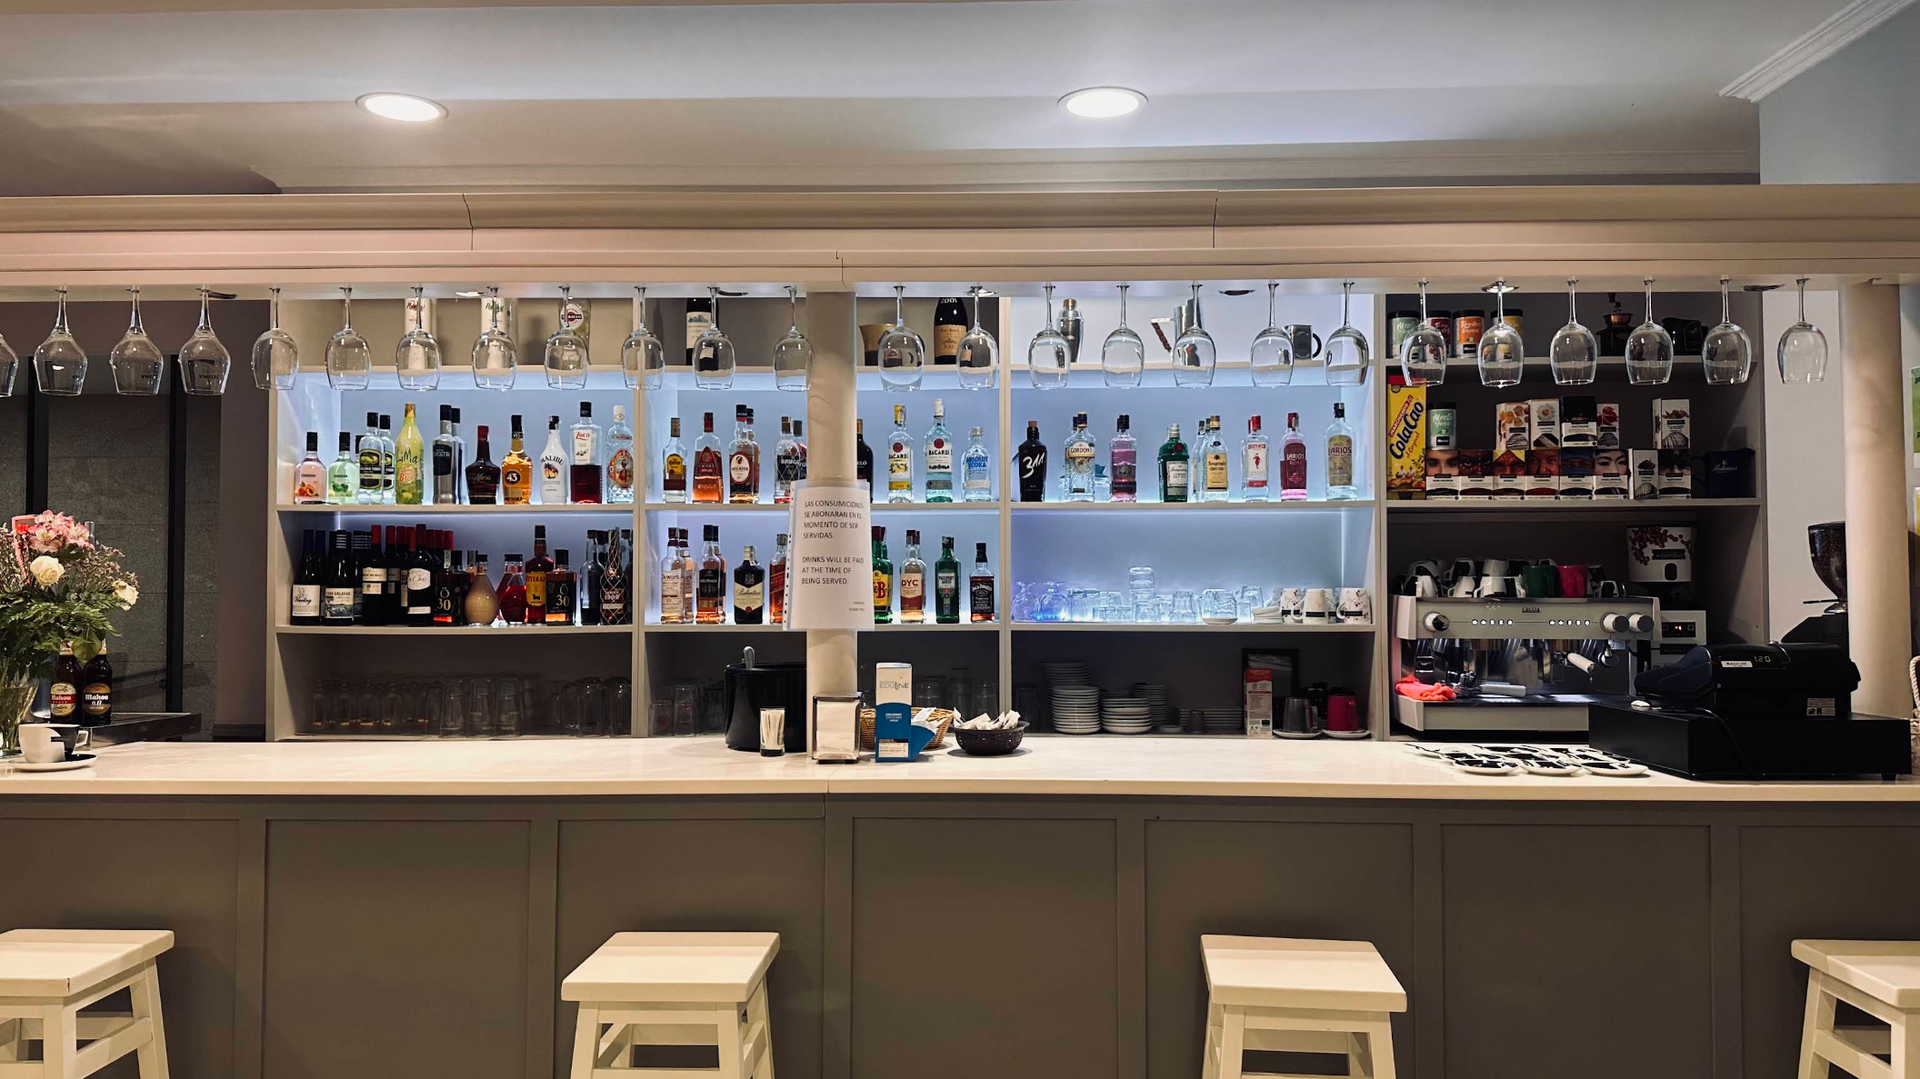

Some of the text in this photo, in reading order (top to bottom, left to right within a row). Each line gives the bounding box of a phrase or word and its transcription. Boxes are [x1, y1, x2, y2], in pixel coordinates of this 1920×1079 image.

[1389, 401, 1424, 460] ColaCao
[1328, 446, 1352, 456] LARIOS
[540, 455, 564, 466] MALIBU
[506, 473, 518, 482] 43
[815, 500, 864, 509] CONSUMICIONES
[802, 577, 849, 585] BEING SERVED.
[901, 579, 919, 587] DYC
[438, 597, 451, 611] 30
[556, 594, 570, 607] 30
